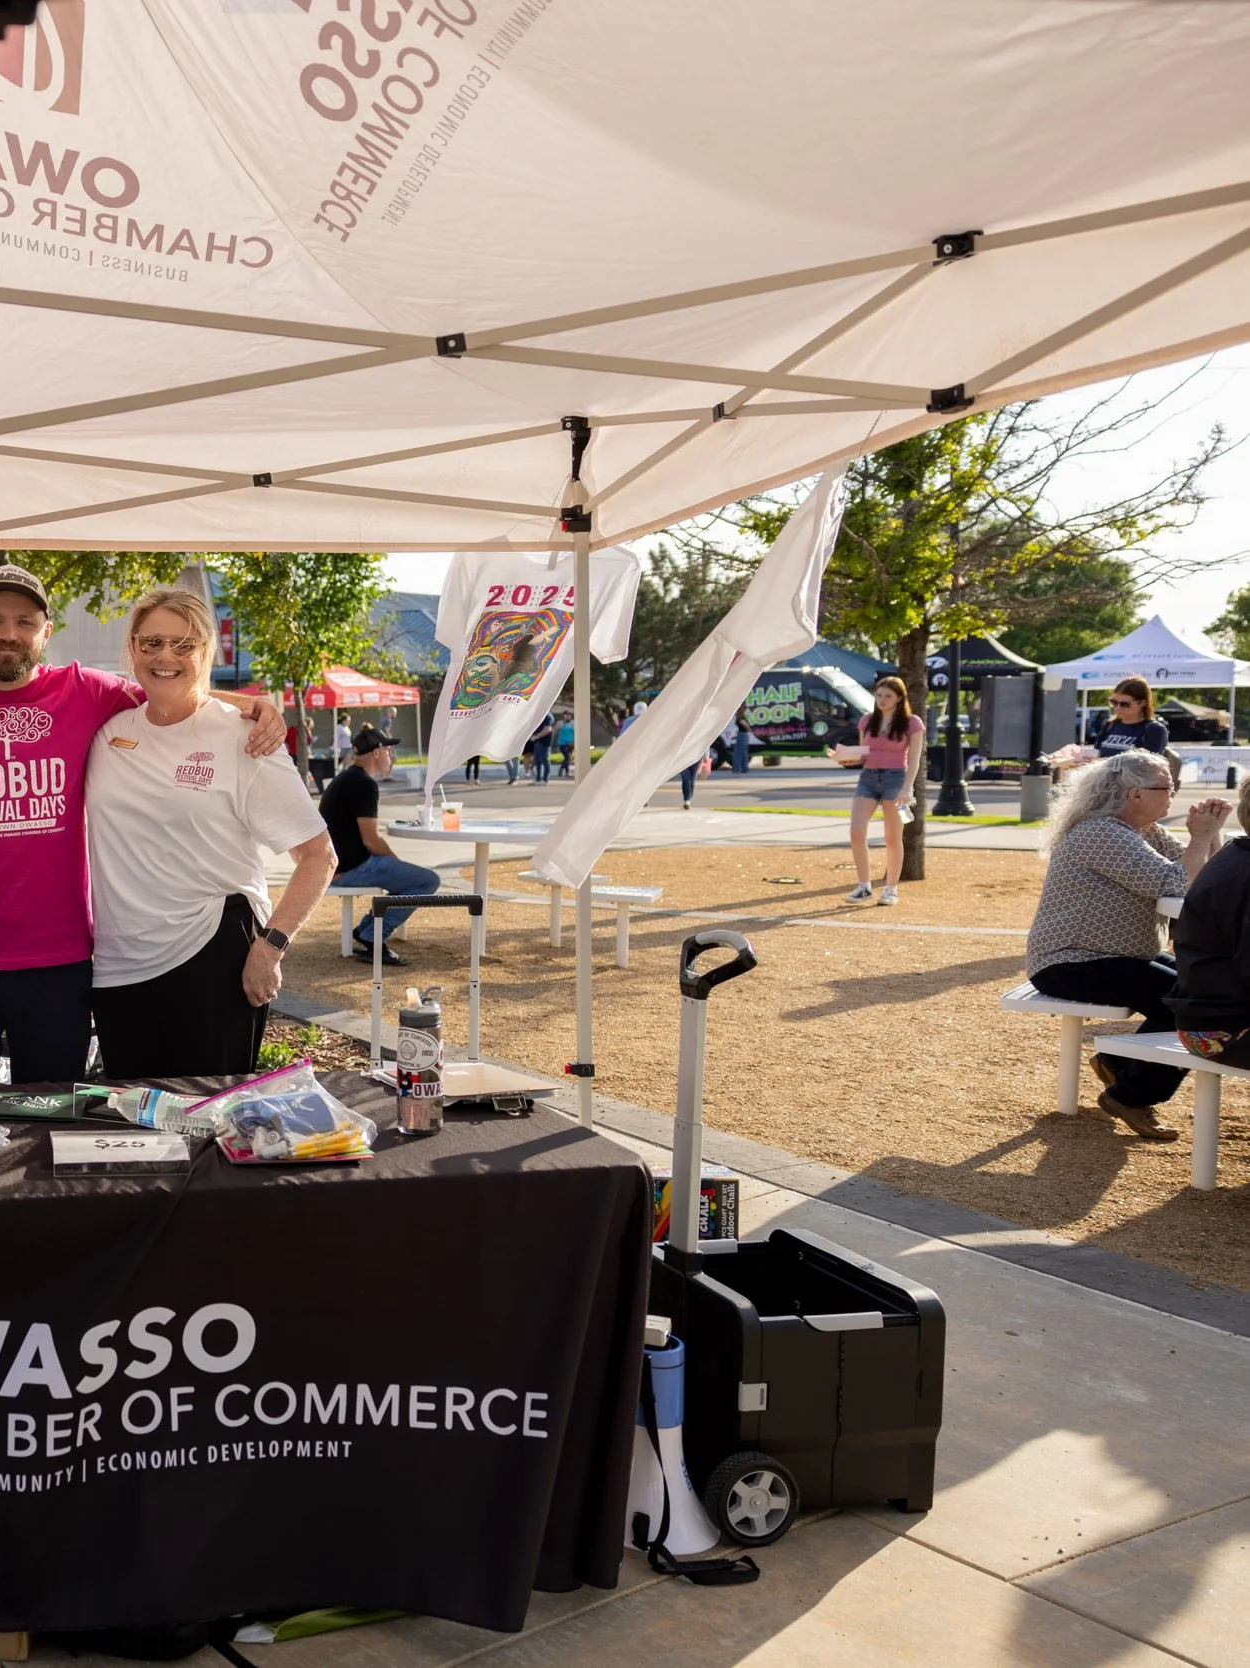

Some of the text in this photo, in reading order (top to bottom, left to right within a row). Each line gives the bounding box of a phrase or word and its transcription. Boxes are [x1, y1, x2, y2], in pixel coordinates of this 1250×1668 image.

[746, 682, 803, 706] HALF
[176, 765, 214, 779] REDBUD
[29, 795, 66, 820] DAYS
[19, 820, 54, 829] OWASSO
[413, 1083, 444, 1097] OWA
[94, 1139, 146, 1149] $25
[700, 1195, 710, 1232] CHALK
[726, 1183, 735, 1239] utdoor Chalk
[121, 1386, 195, 1434] OF
[215, 1381, 549, 1438] COMMERCE
[97, 1448, 198, 1474] ECONOMIC
[207, 1441, 352, 1463] DEVELOPMENT
